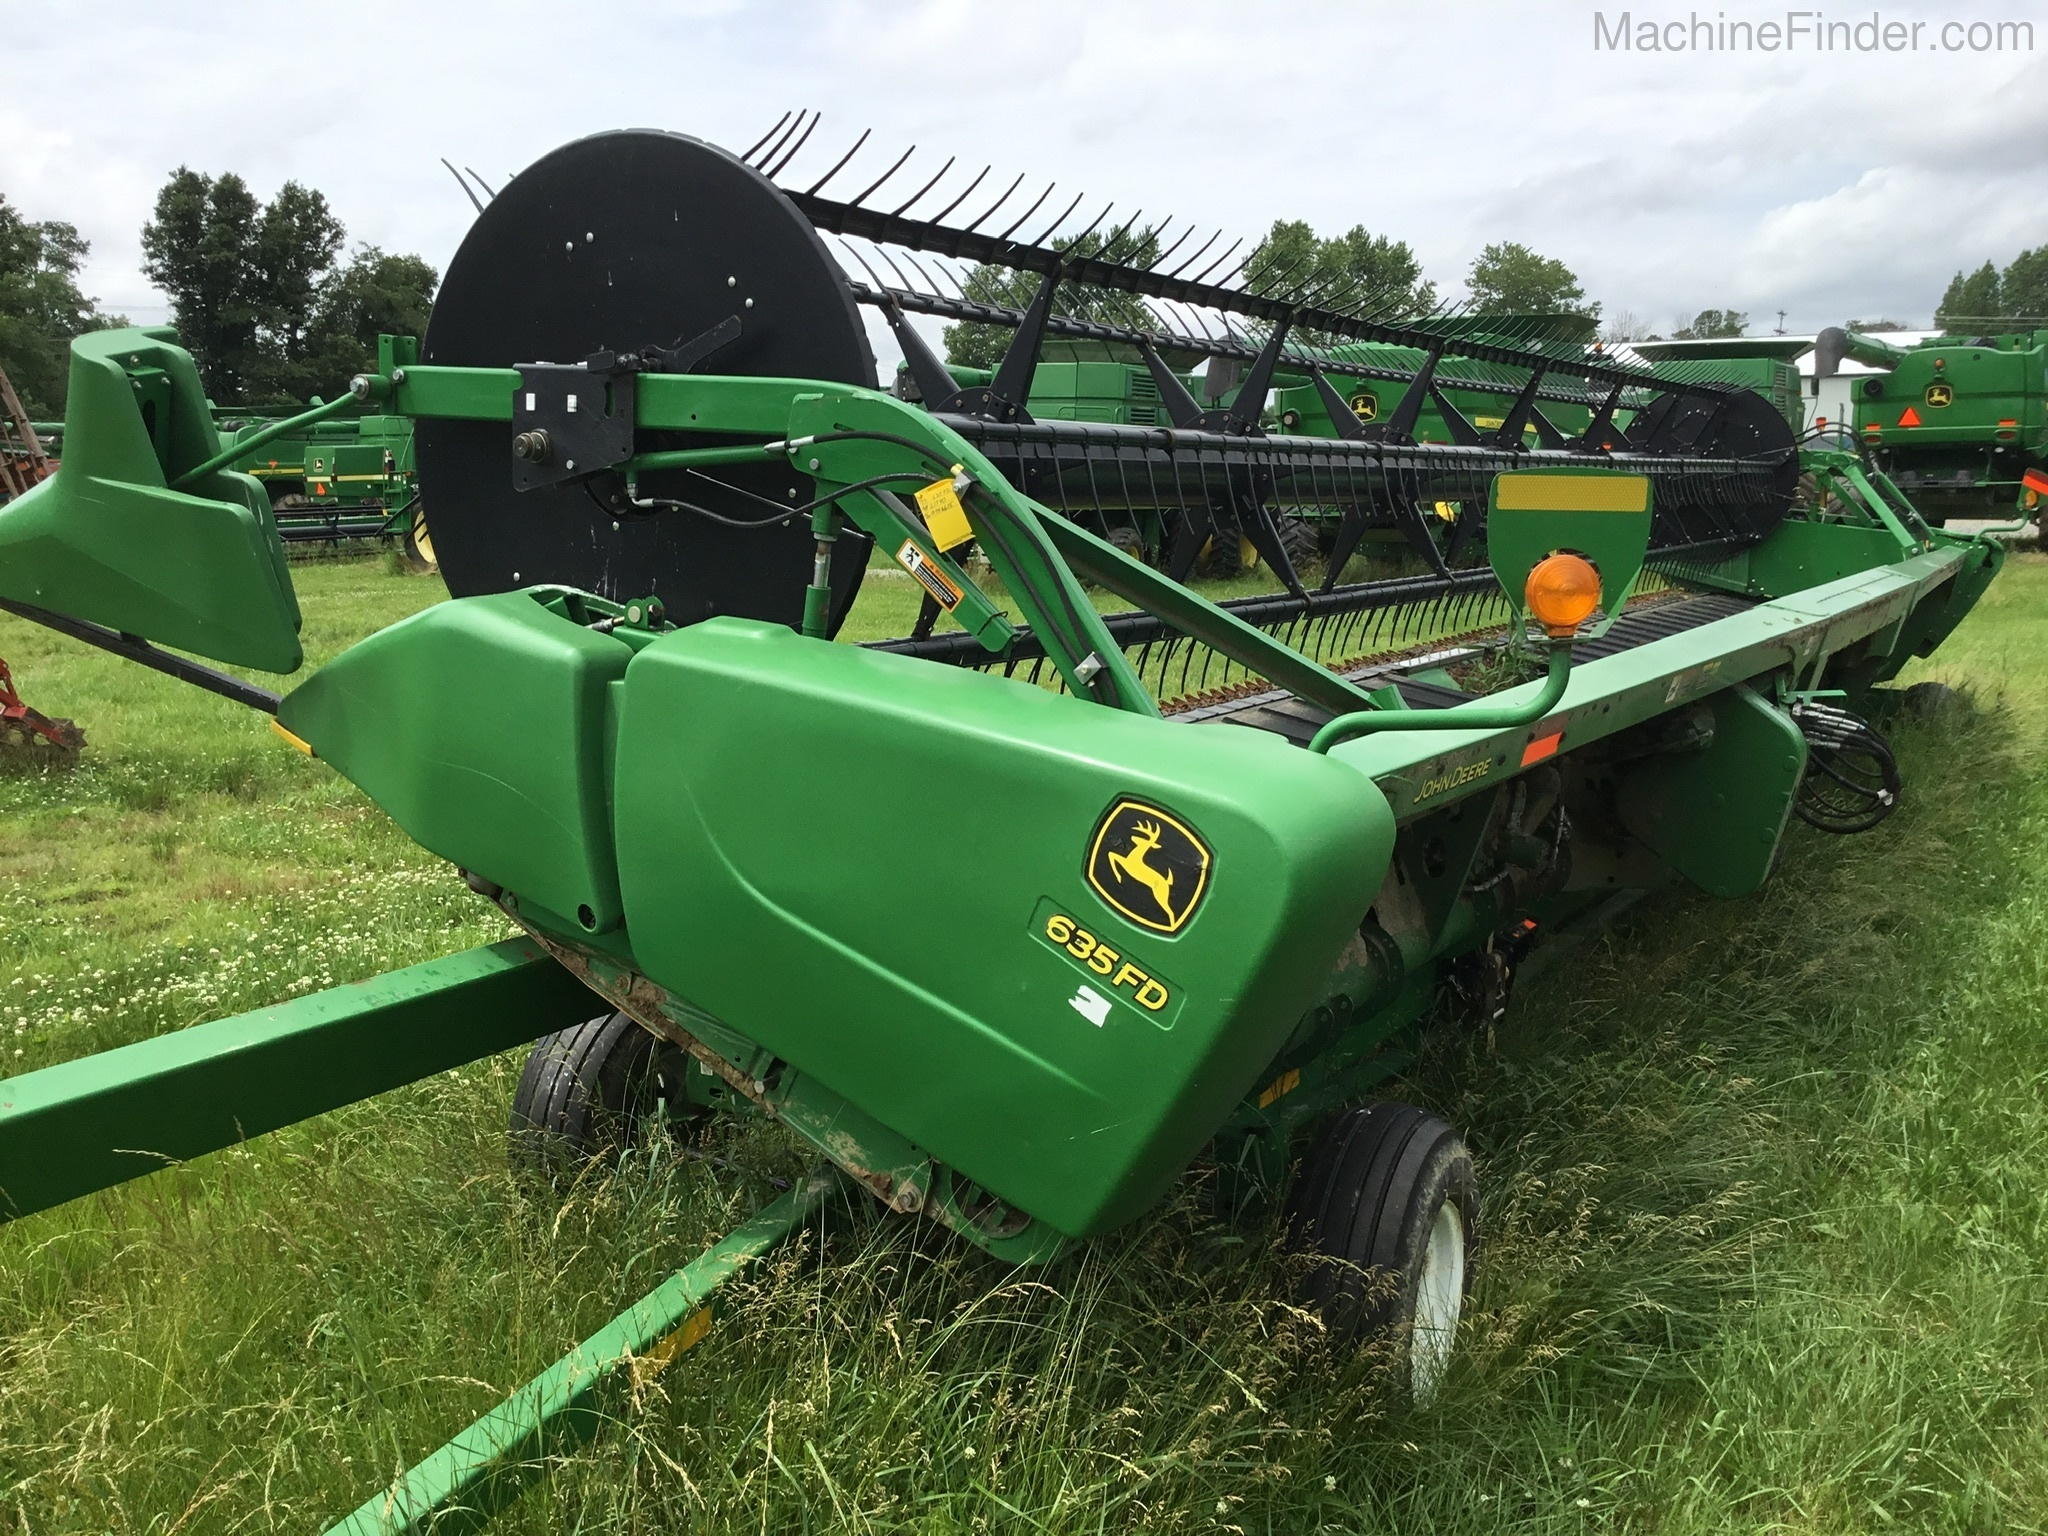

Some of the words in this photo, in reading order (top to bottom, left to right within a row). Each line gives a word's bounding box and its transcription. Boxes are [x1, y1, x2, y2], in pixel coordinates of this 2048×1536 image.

[935, 569, 957, 592] WARNING
[1413, 776, 1452, 804] JOHN
[1450, 758, 1492, 788] DEERE
[1045, 913, 1170, 1011] 635FD
